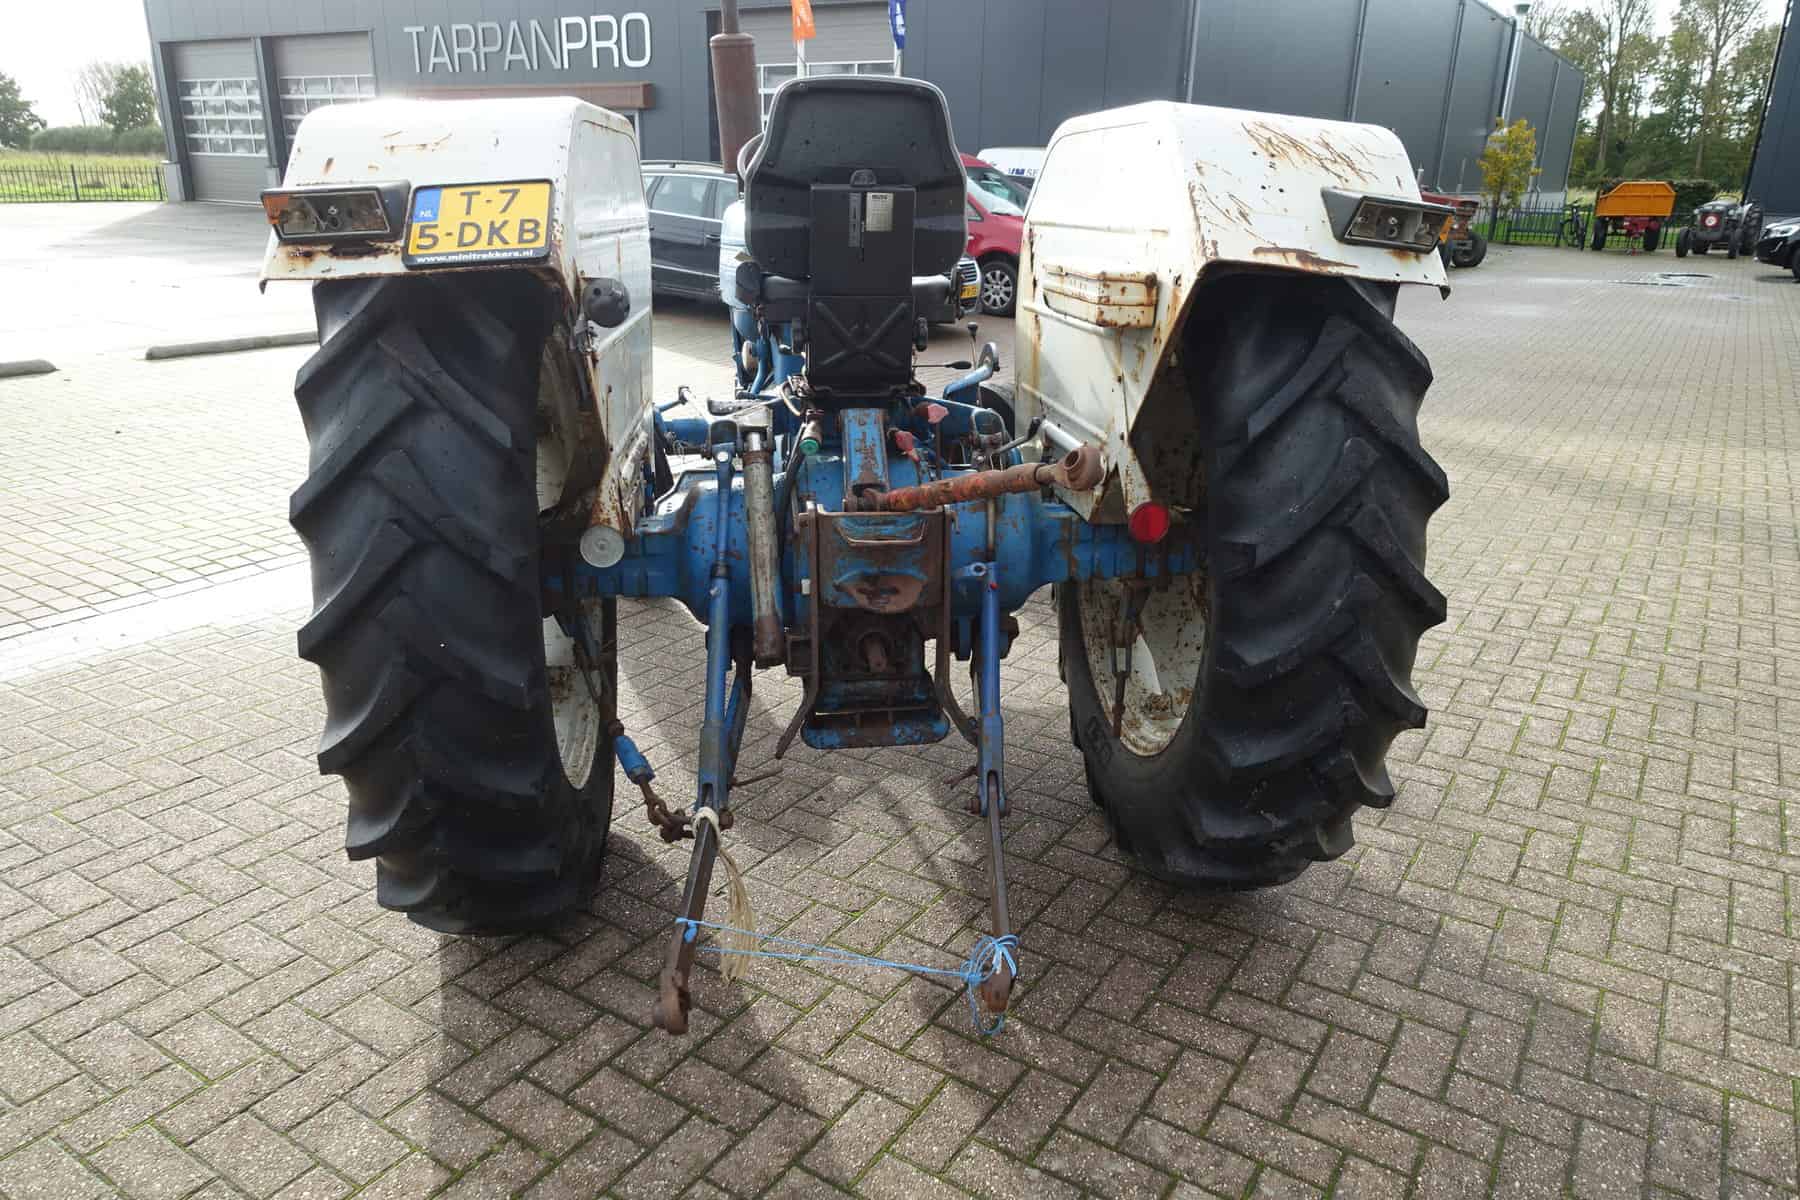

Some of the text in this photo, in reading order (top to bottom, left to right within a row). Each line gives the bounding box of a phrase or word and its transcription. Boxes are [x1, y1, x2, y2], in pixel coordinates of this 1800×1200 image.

[403, 12, 651, 73] TARPANPRO
[420, 210, 433, 218] NL
[460, 188, 520, 215] T-7
[416, 219, 541, 250] 5-DKB
[416, 250, 534, 263] www.minitrekkers.nl
